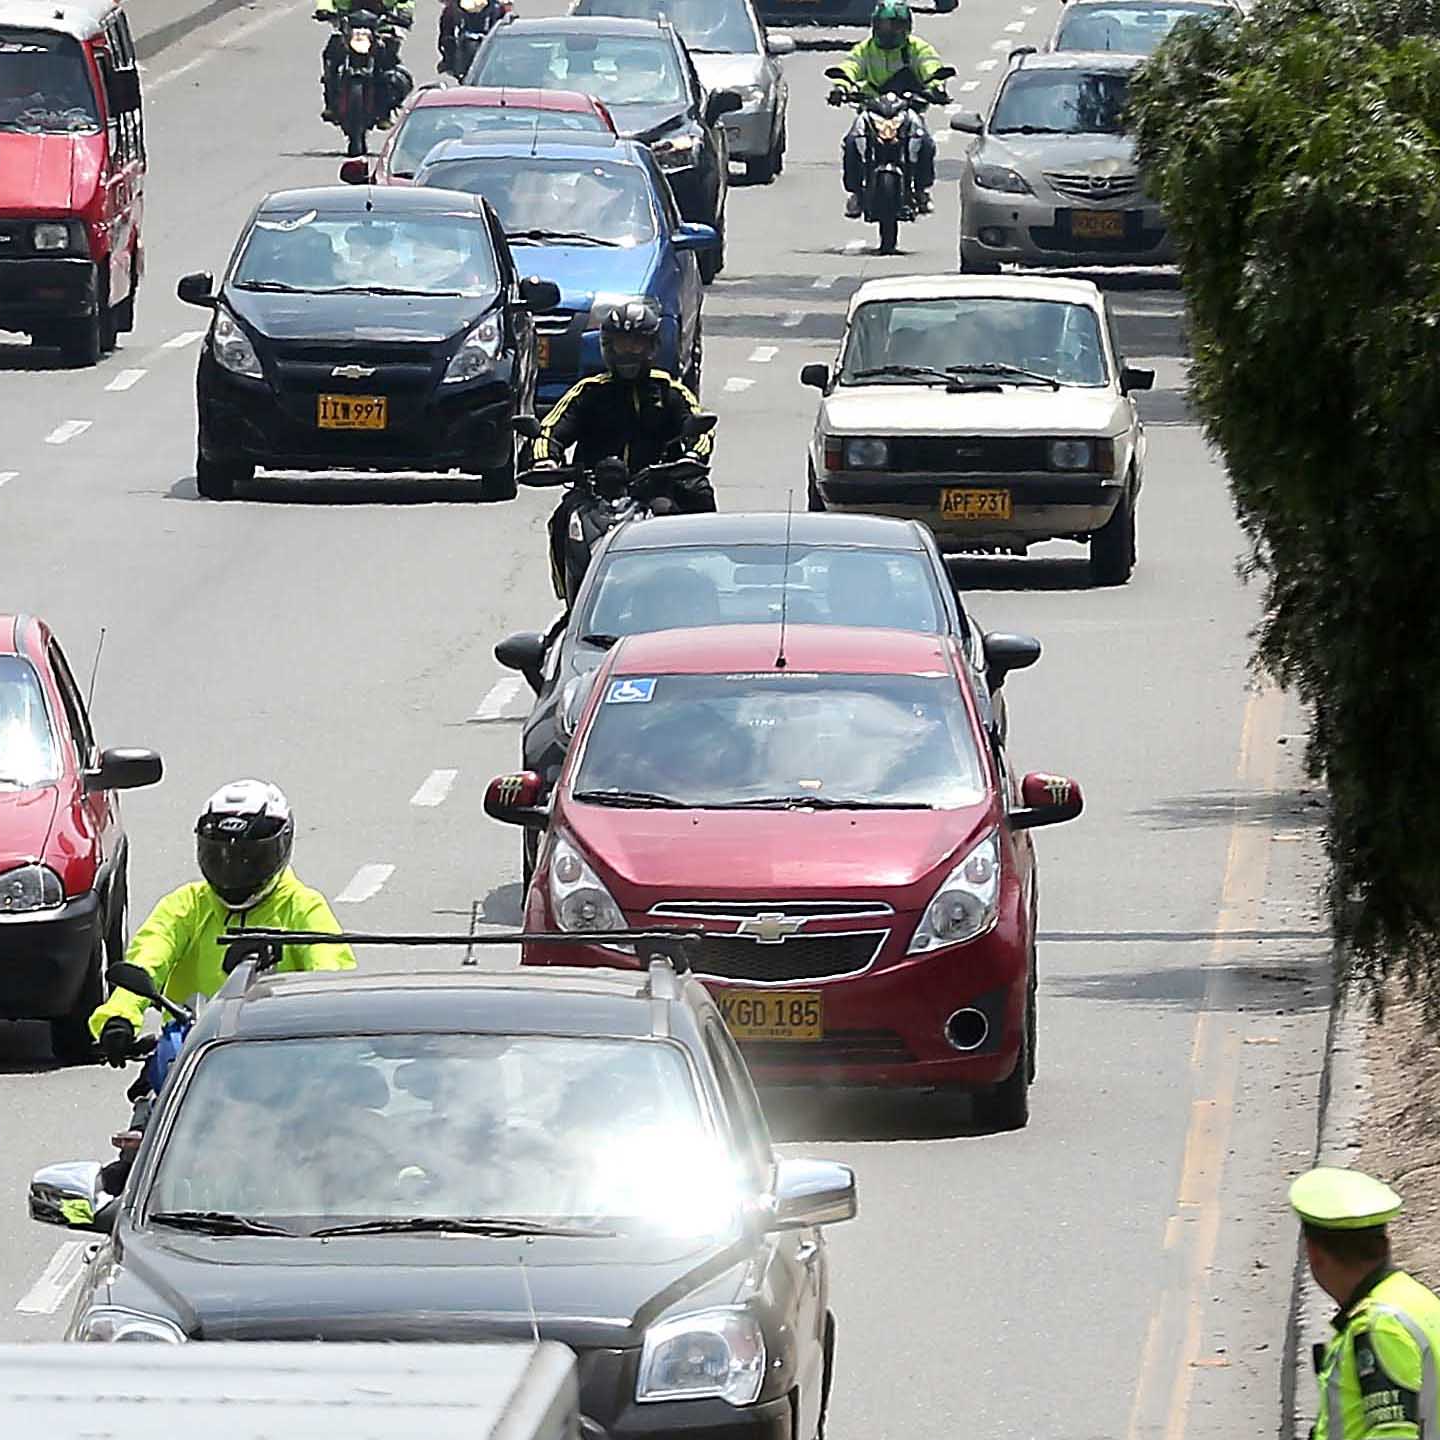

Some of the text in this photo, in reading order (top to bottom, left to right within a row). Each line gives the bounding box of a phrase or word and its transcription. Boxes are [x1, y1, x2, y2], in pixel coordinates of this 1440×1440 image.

[354, 402, 384, 420] 997
[943, 491, 1009, 512] APF 937
[774, 1000, 818, 1026] 185
